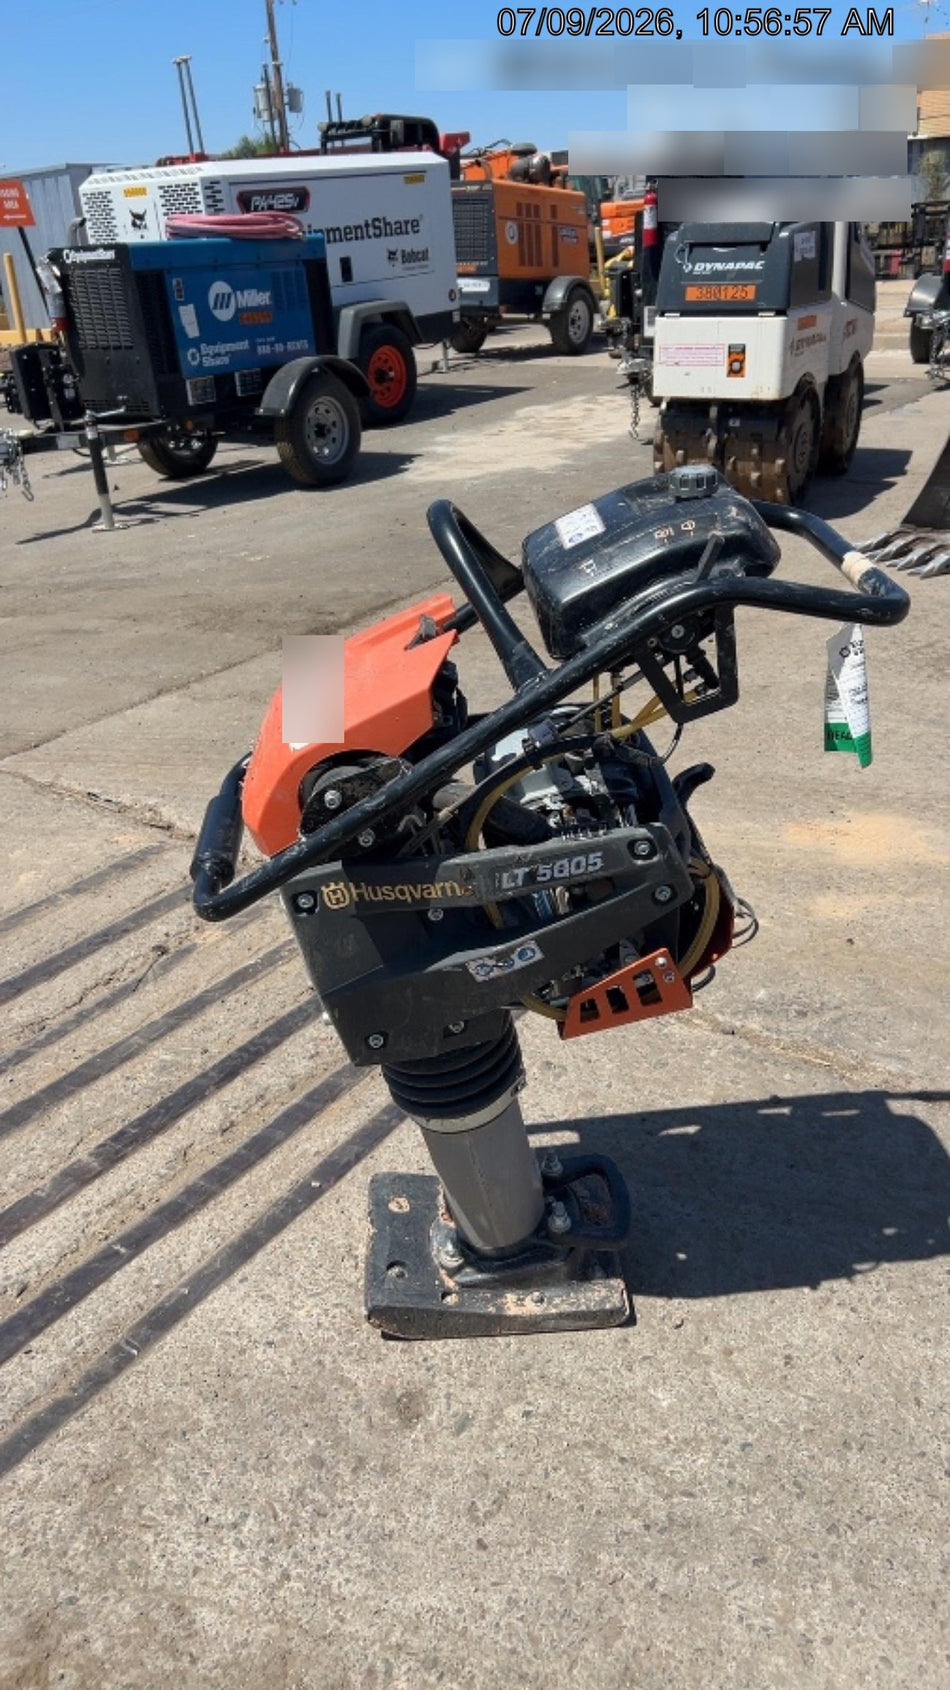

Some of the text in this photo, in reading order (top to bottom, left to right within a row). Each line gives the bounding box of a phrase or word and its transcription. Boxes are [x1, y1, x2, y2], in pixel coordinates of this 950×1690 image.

[401, 248, 429, 264] Bobcat
[693, 260, 765, 272] DYNAPAC
[236, 289, 271, 309] Miller
